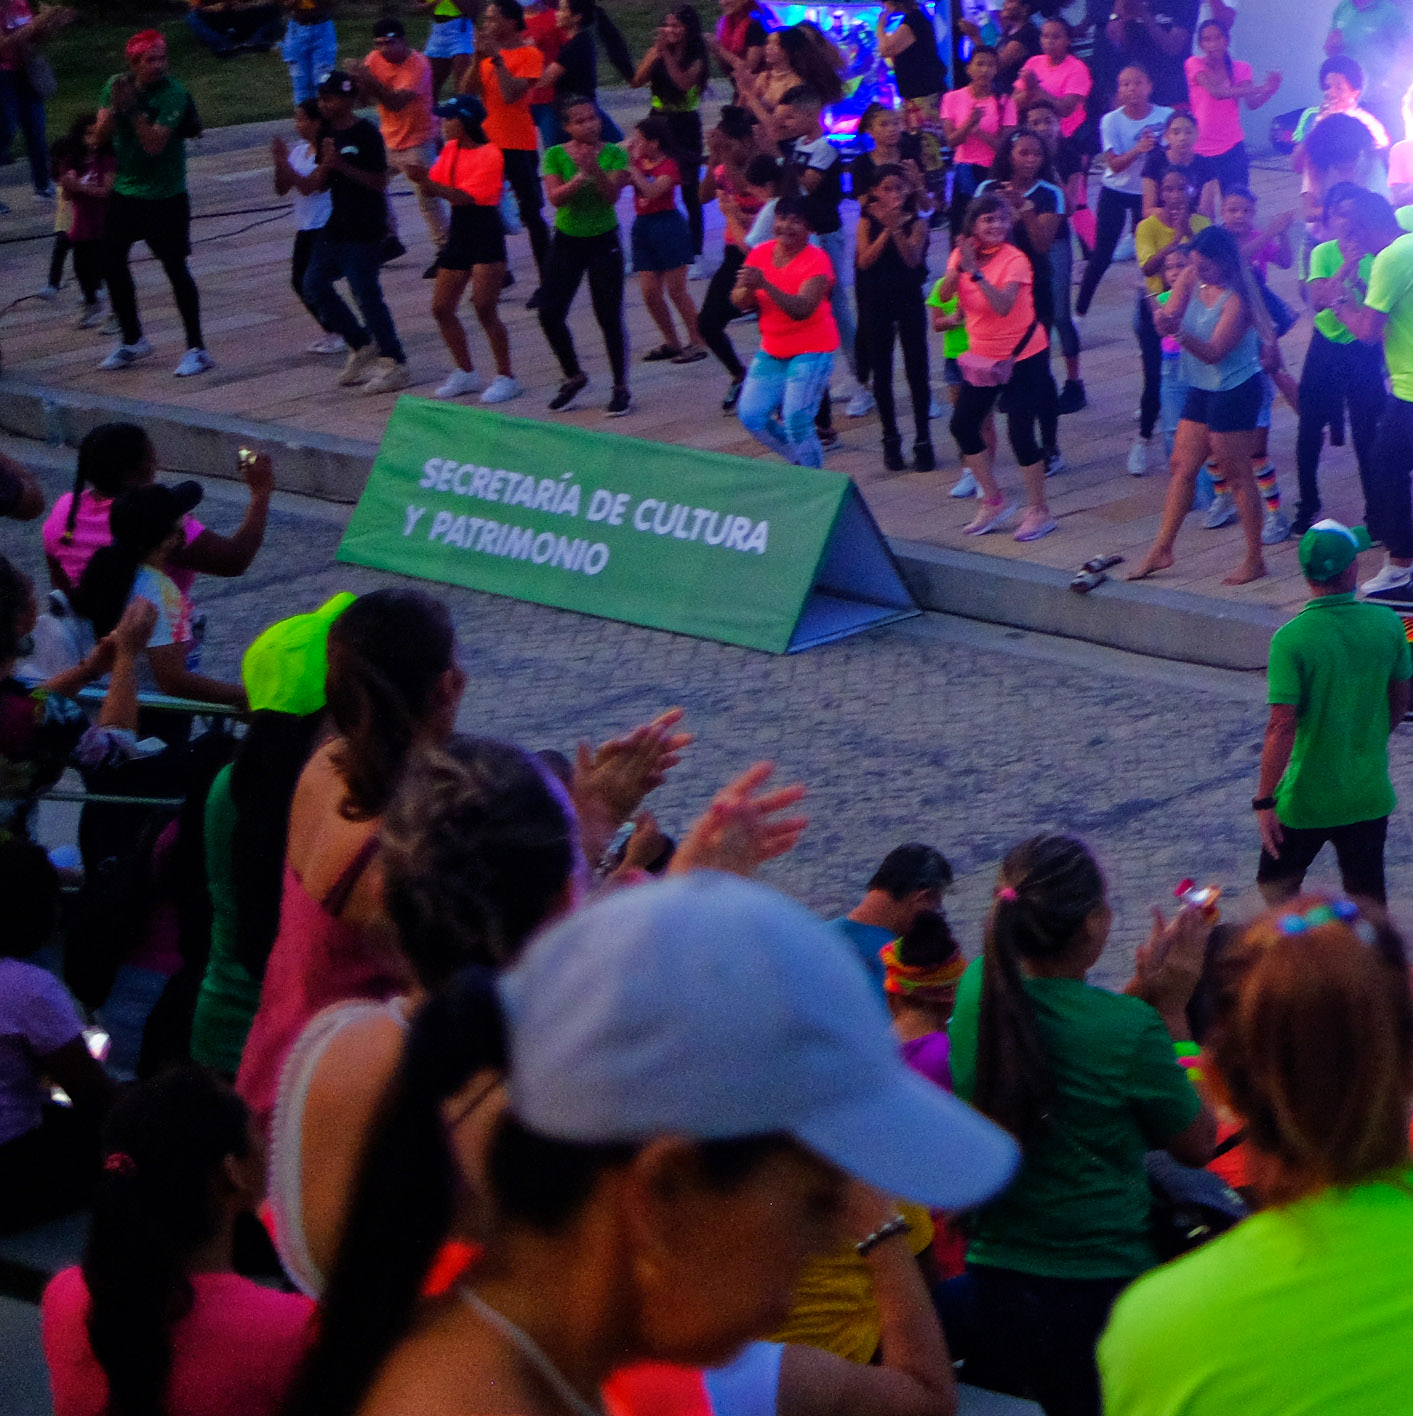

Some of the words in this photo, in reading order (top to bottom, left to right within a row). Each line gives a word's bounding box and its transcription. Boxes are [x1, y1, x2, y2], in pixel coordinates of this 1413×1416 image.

[403, 505, 427, 536] Y
[430, 510, 610, 575] PATRIMONIO
[420, 456, 581, 518] SECRETARÍA
[587, 488, 628, 526] DE
[633, 497, 769, 555] CULTURA
